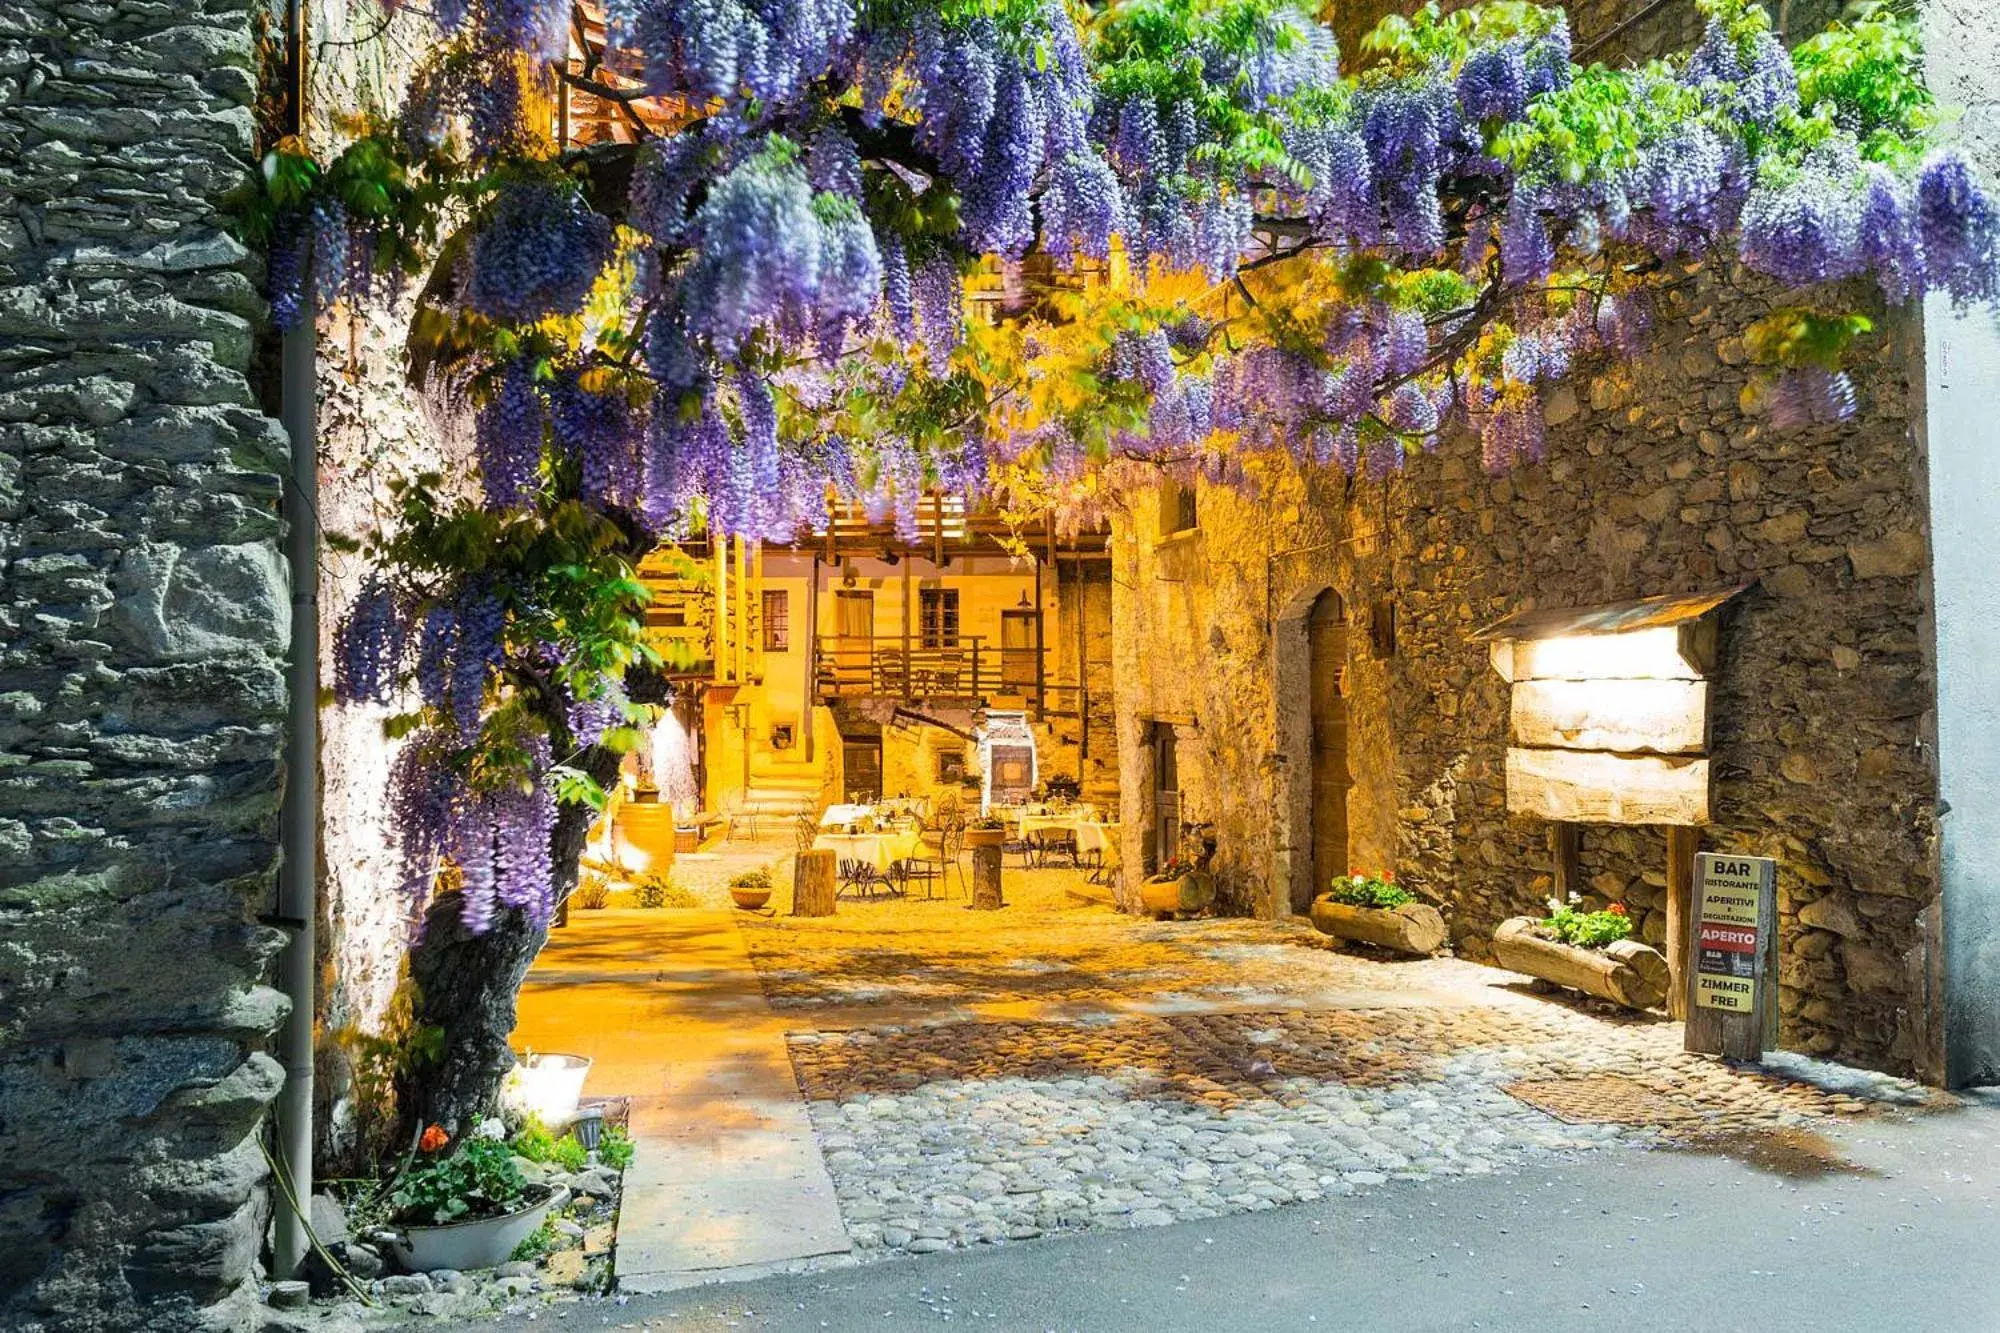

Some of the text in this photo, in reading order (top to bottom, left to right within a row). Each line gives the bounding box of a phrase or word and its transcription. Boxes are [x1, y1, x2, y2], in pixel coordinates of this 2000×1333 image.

[1714, 861, 1750, 876] BAR
[1705, 879, 1759, 890] RISTORANTE
[1706, 896, 1754, 907] APERITIVI
[1701, 929, 1755, 944] APERTO
[1701, 979, 1749, 993] ZIMMER
[1711, 995, 1738, 1007] FREI
